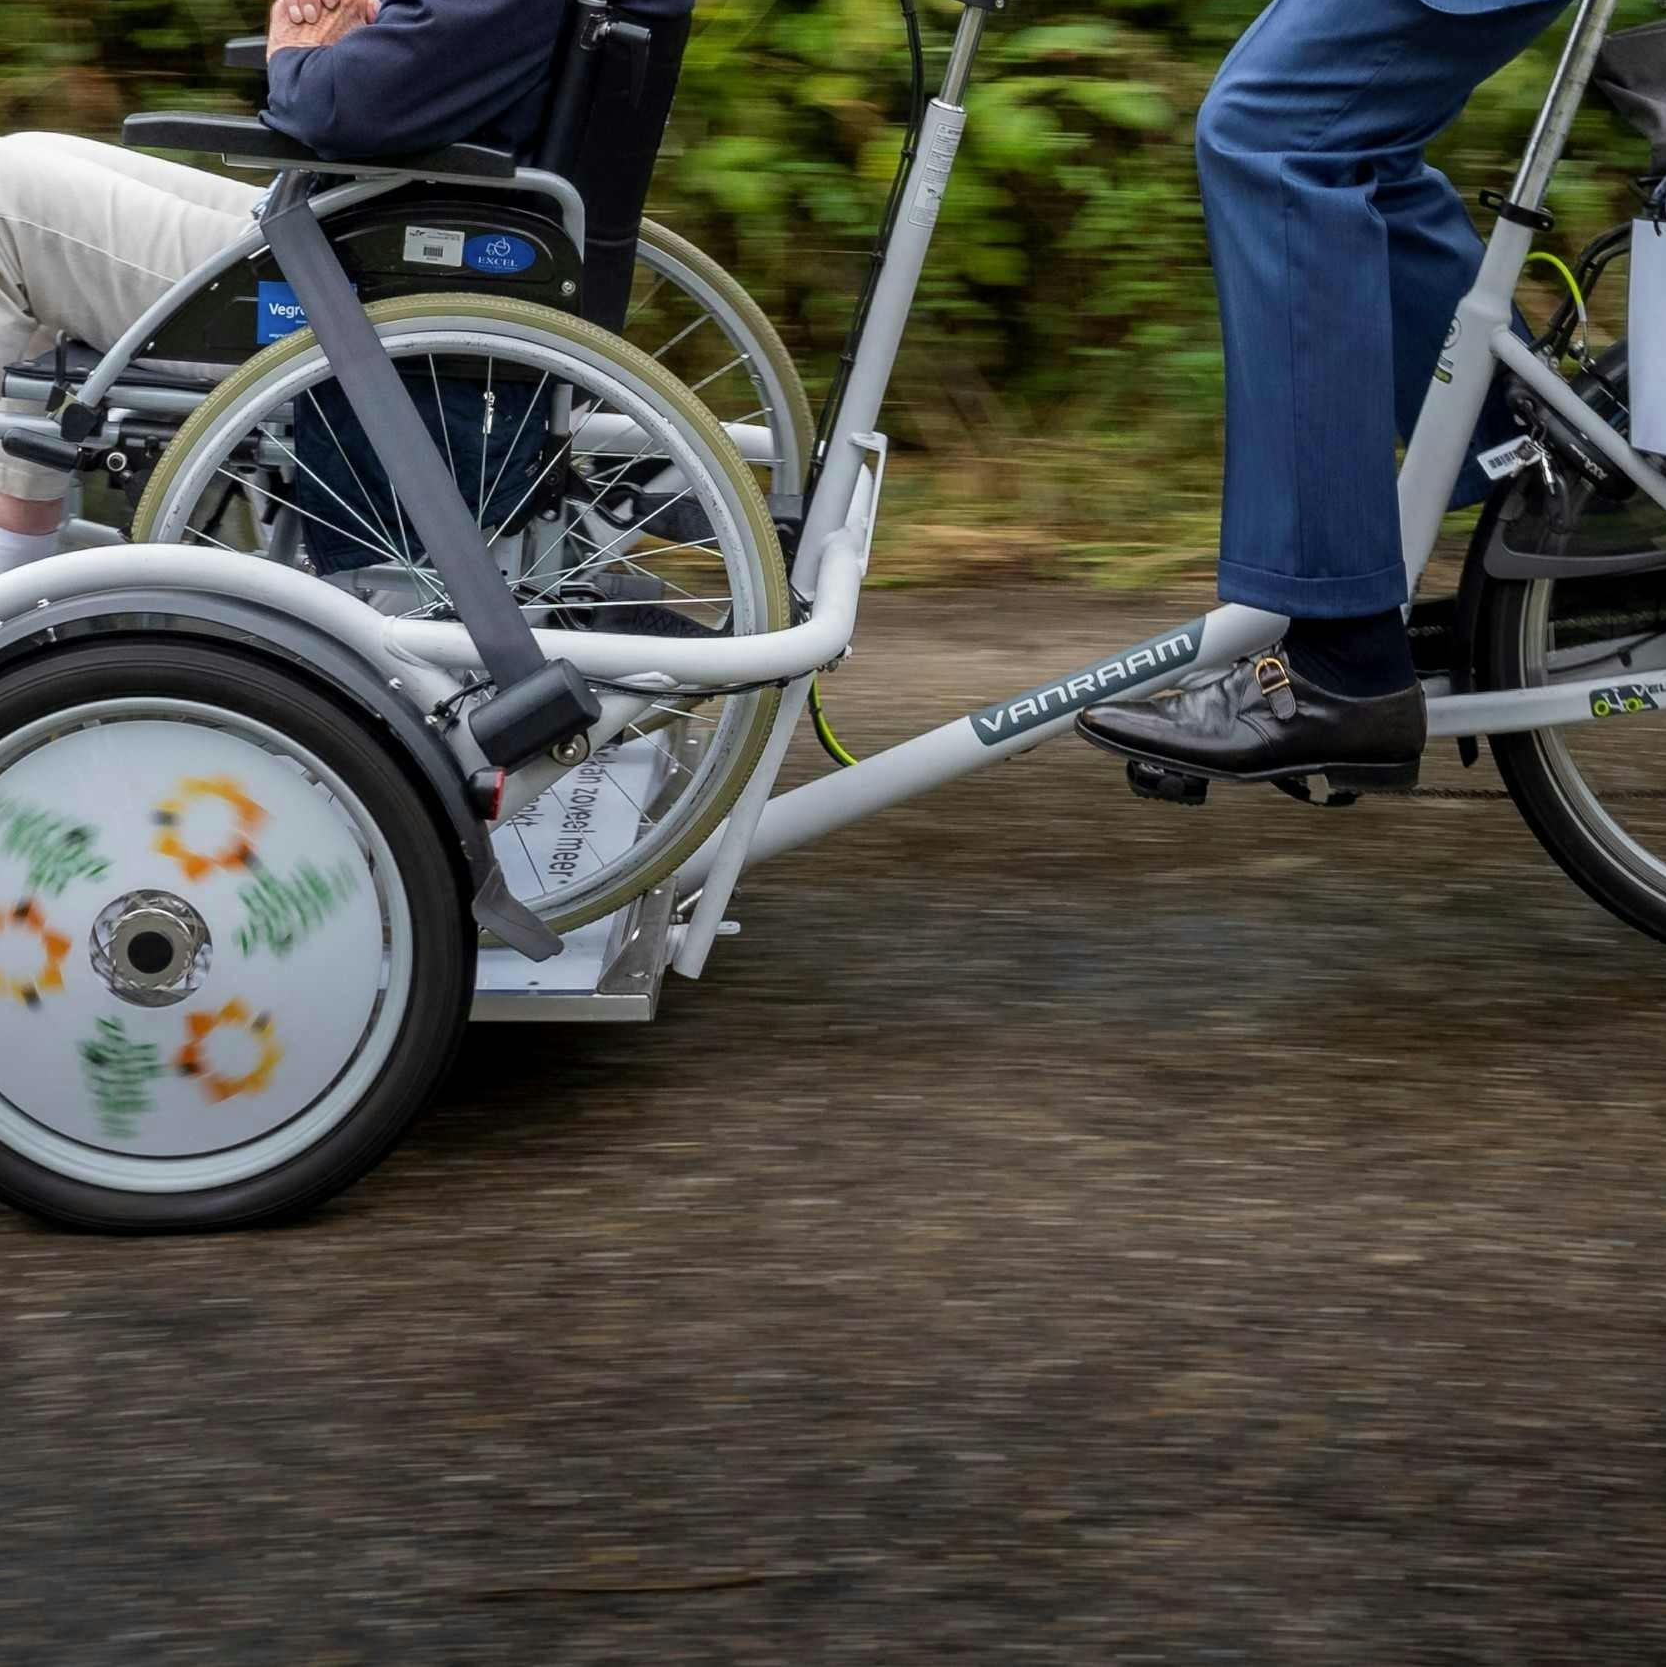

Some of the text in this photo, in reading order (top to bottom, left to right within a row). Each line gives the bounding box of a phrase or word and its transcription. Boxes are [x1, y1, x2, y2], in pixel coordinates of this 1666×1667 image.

[477, 256, 518, 267] EXCEL
[979, 633, 1194, 733] VANRAAM
[559, 788, 600, 834] zoveel
